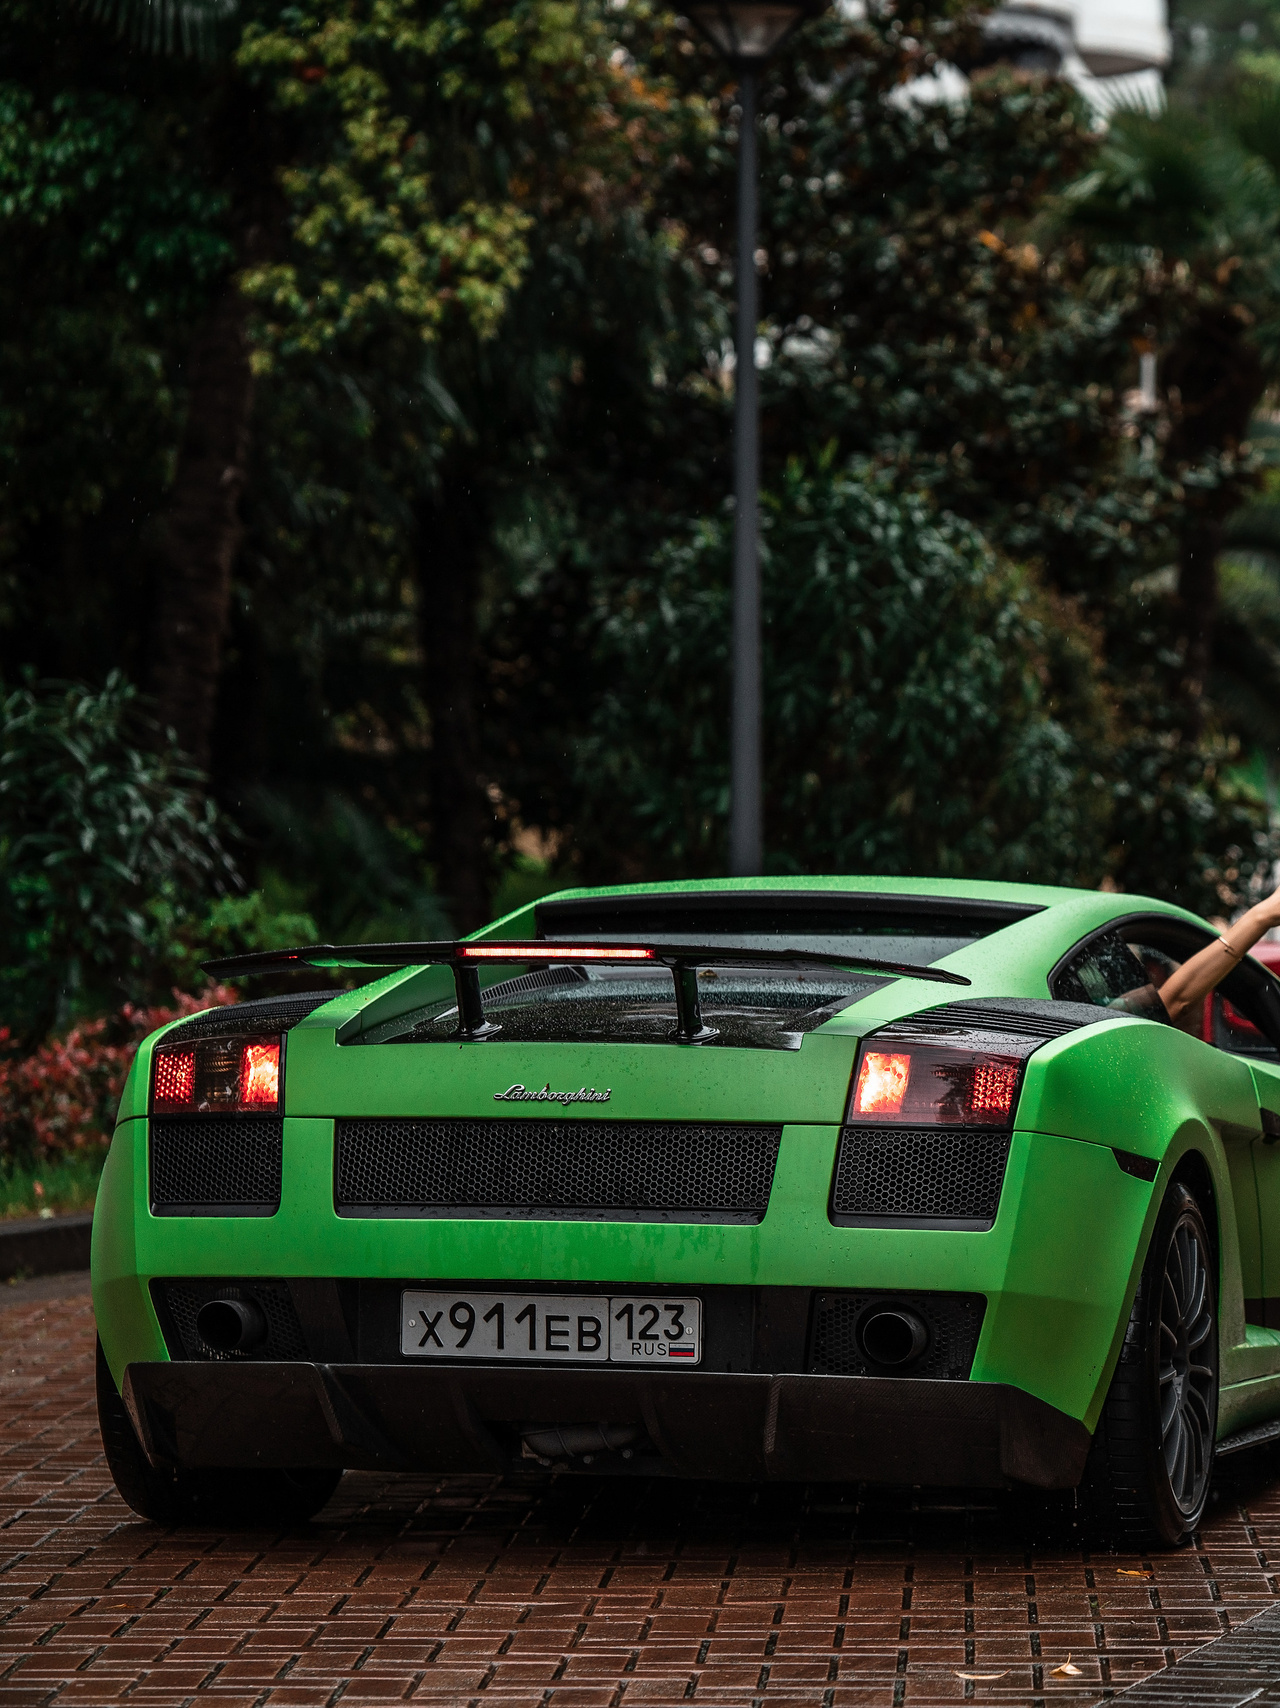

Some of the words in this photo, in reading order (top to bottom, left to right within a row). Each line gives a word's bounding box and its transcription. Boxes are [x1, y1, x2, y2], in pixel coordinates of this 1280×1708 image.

[493, 1083, 612, 1106] Lamborghini
[614, 1303, 685, 1341] 123
[631, 1342, 667, 1356] RUS
